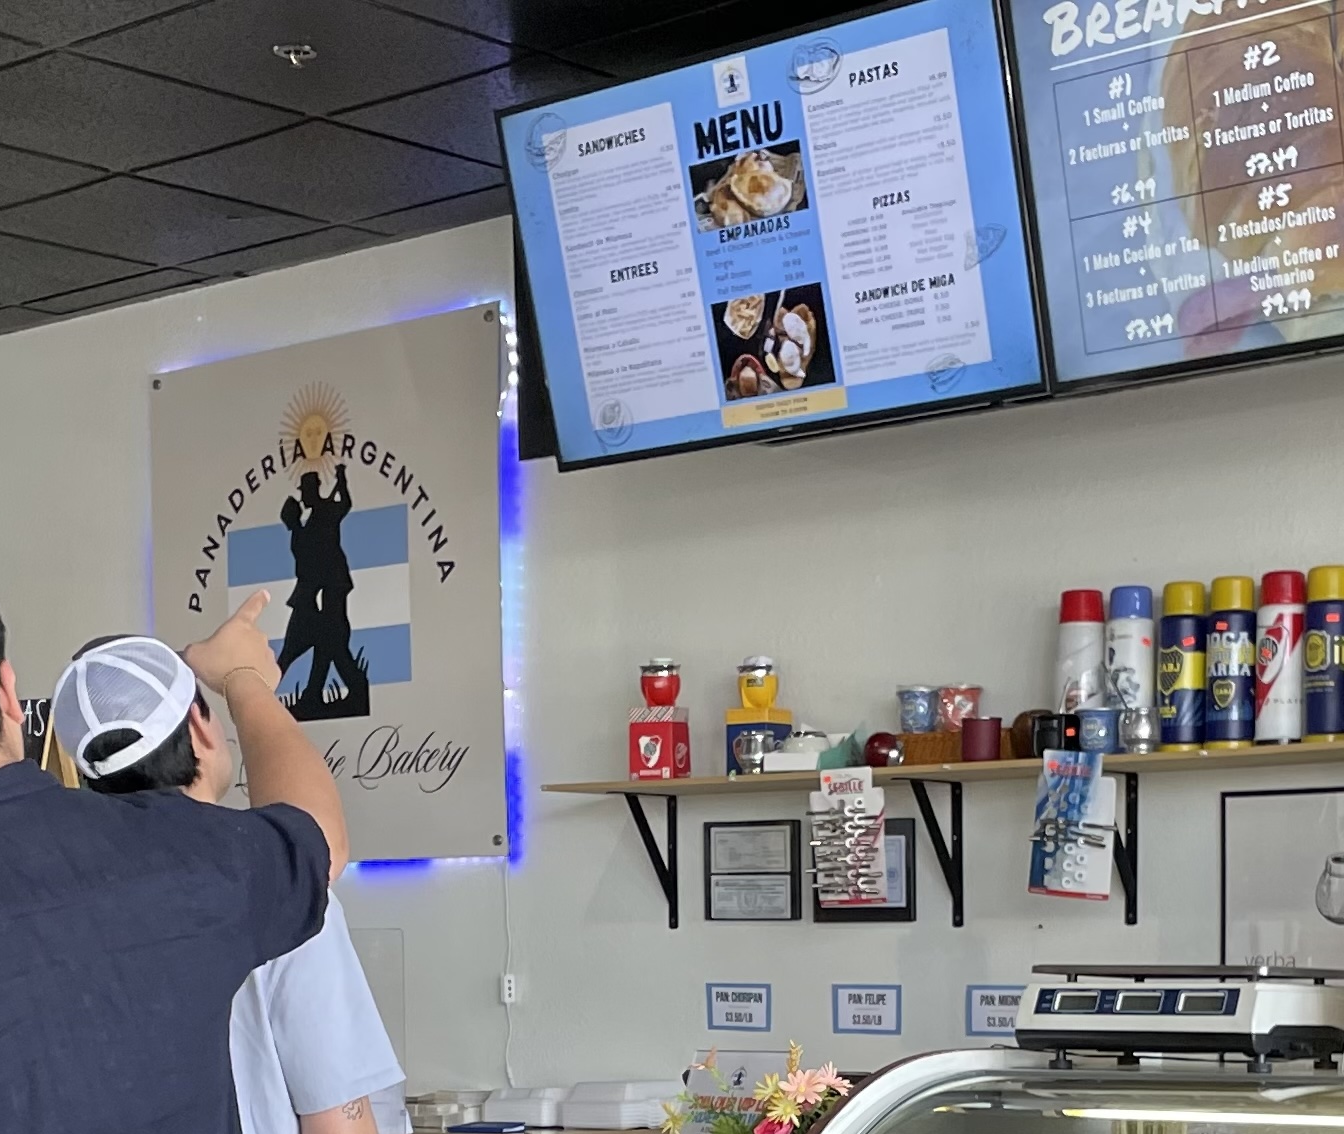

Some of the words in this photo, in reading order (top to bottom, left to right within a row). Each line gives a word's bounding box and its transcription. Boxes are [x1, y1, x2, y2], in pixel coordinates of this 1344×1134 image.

[1243, 40, 1281, 71] #2
[849, 61, 899, 88] PASTAS
[1108, 73, 1132, 100] #1
[1213, 90, 1221, 107] 1
[1223, 80, 1272, 106] Medium
[1274, 71, 1315, 94] Coffee
[1083, 110, 1091, 126] 1
[1093, 103, 1125, 125] Small
[1127, 95, 1165, 119] Coffee
[693, 100, 784, 159] MENU
[1203, 131, 1212, 149] 3
[1215, 121, 1266, 147] Facturas
[1269, 117, 1283, 134] or
[1285, 106, 1334, 130] Tortitas
[578, 128, 646, 157] SANDWICHES
[1069, 149, 1077, 165] 2
[1079, 139, 1127, 164] Facturas
[1130, 136, 1142, 151] or
[1144, 125, 1190, 149] Tortitas
[872, 190, 911, 209] PIZZAS
[1258, 183, 1292, 211] #5
[719, 216, 790, 243] EMPANADAS
[1122, 211, 1152, 238] #4
[1218, 225, 1227, 242] 2
[1165, 241, 1177, 255] or
[1233, 254, 1279, 278] Medium
[1283, 247, 1322, 267] Coffee
[1326, 243, 1339, 258] or
[610, 261, 659, 283] ENTREES
[1250, 268, 1314, 293] Submarino
[855, 282, 908, 304] SANDWICH
[911, 278, 926, 292] DE
[1086, 292, 1093, 308] 3
[1096, 284, 1143, 306] Facturas
[1147, 281, 1159, 296] or
[1161, 272, 1206, 293] Tortitas
[189, 437, 306, 614] PANADERÍA
[321, 432, 455, 584] ARGENTINA
[352, 724, 470, 793] Bakery
